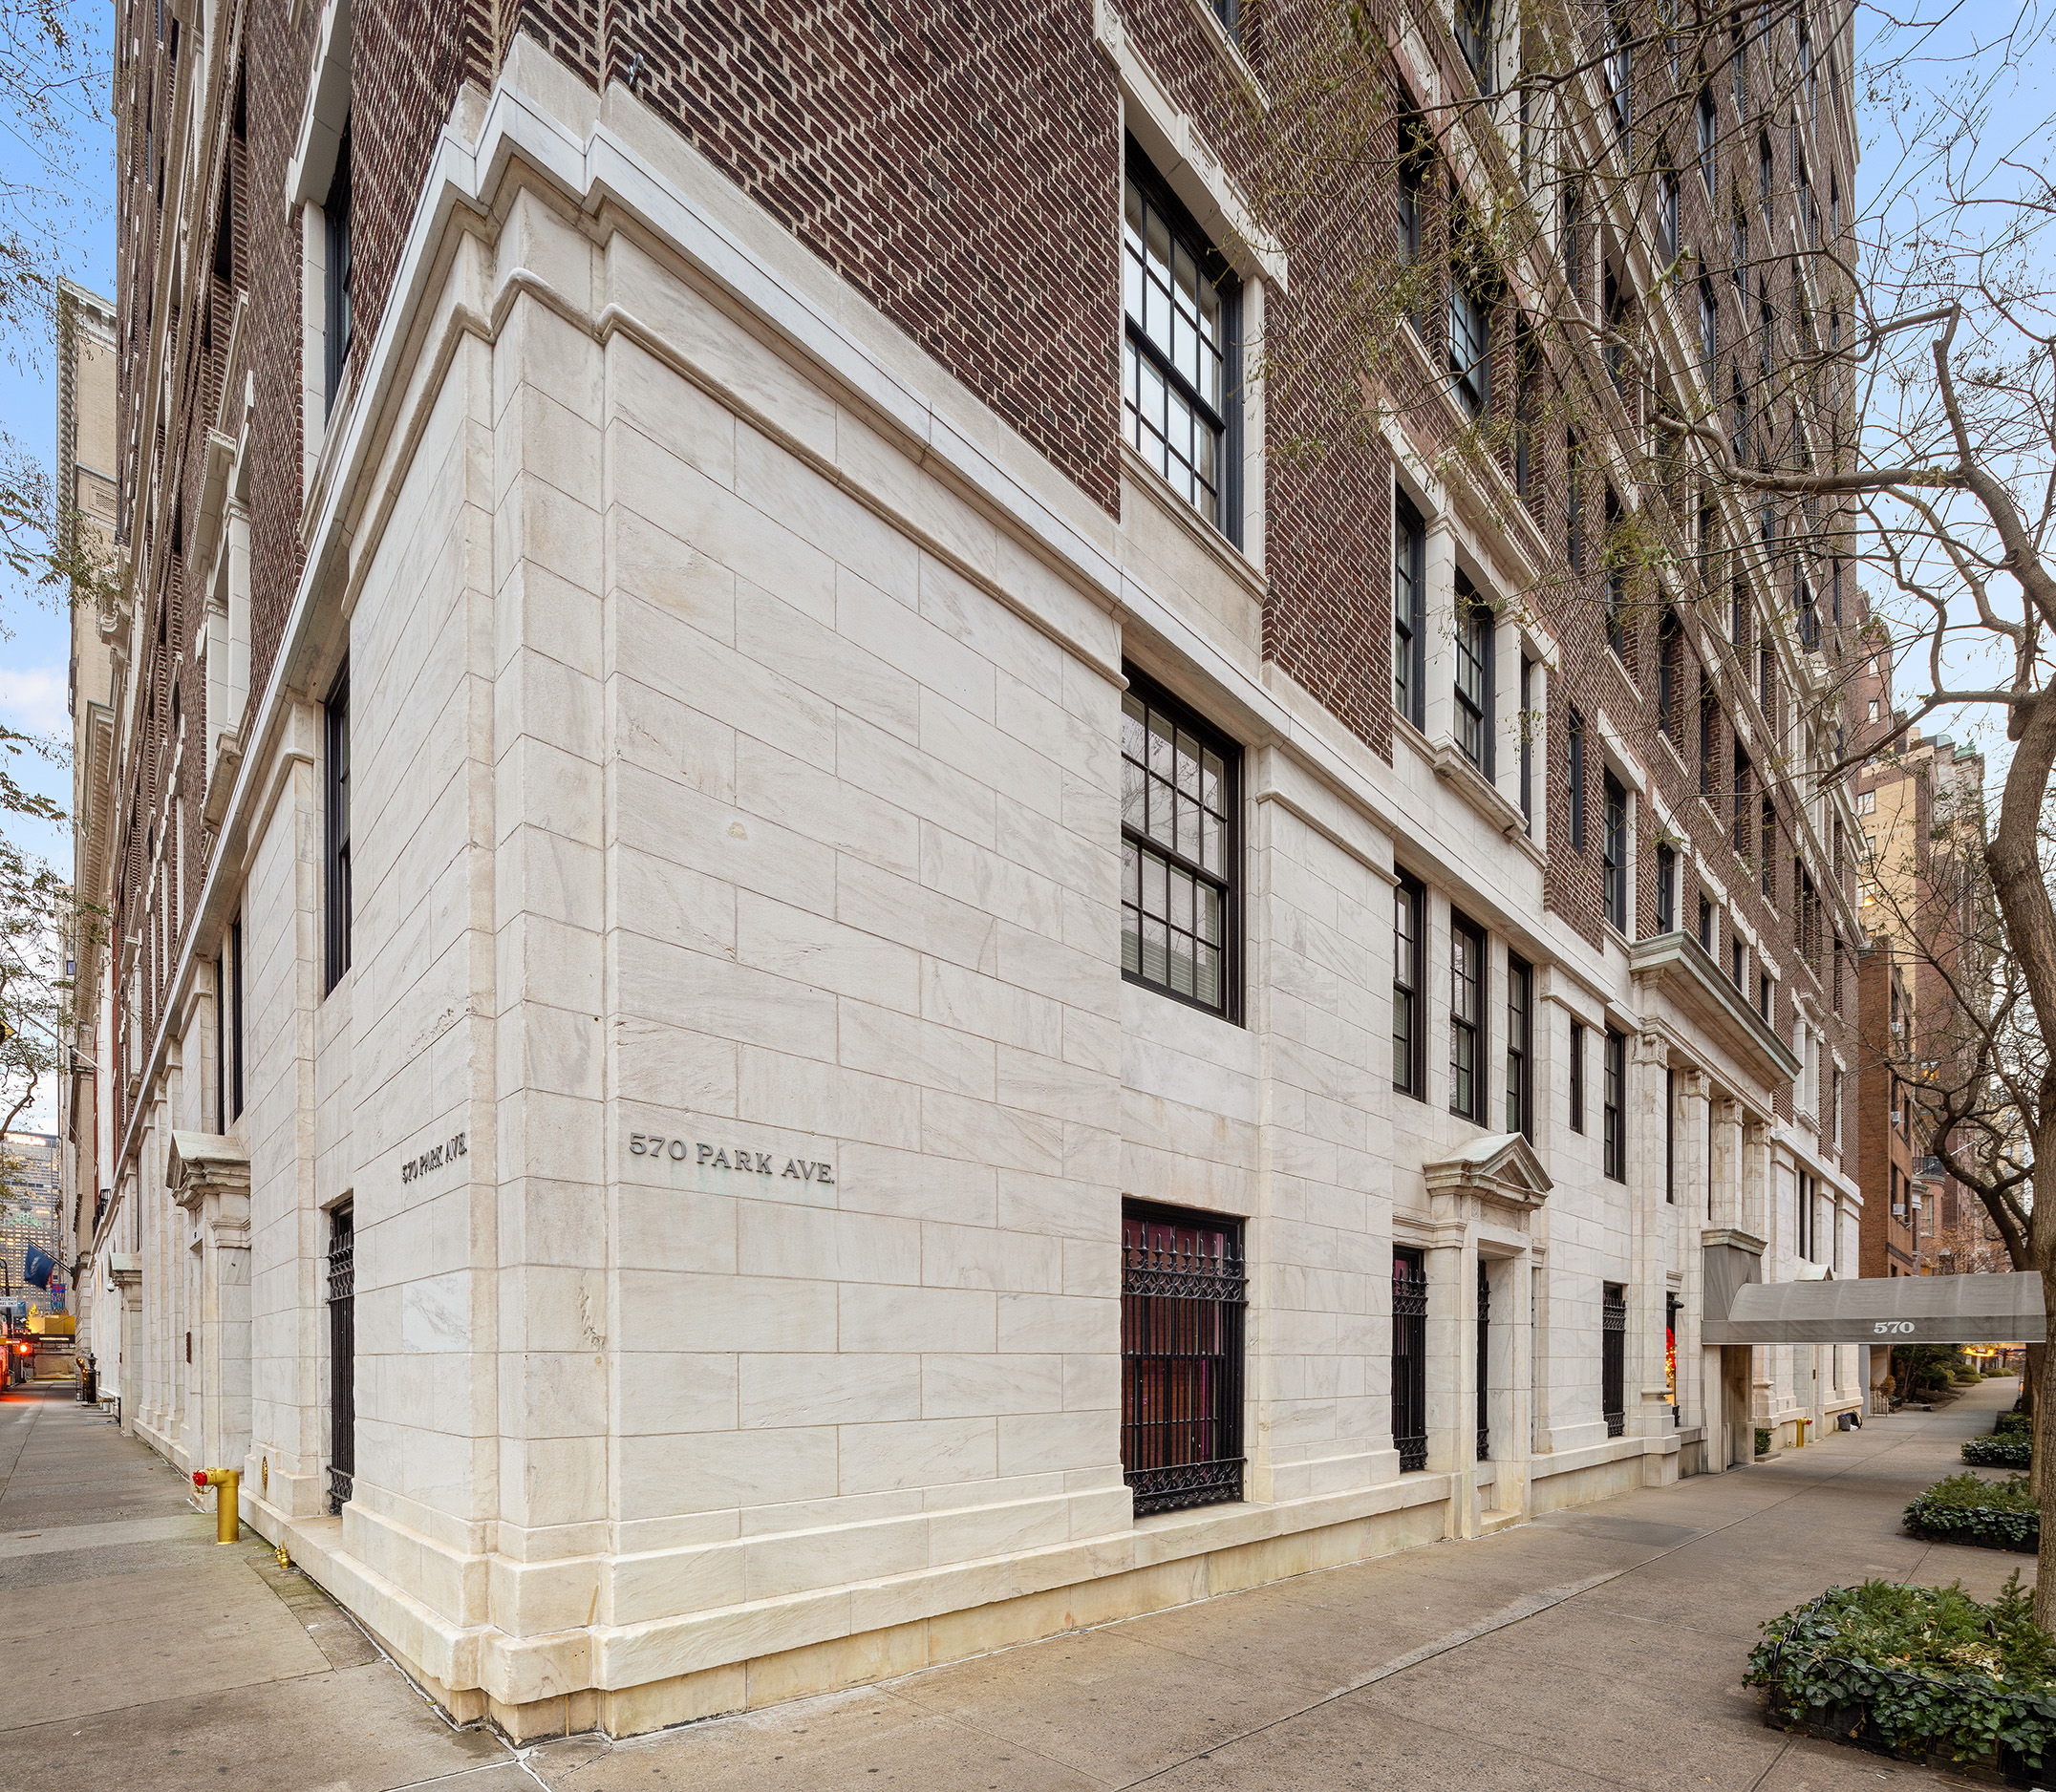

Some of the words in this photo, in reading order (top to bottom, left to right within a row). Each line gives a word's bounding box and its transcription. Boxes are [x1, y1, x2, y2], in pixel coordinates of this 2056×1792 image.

[401, 1159, 418, 1184] 570
[419, 1144, 443, 1176] PARK
[629, 1132, 687, 1161] 570
[696, 1142, 773, 1175] PARK
[781, 1159, 835, 1184] AVE.
[1874, 1321, 1915, 1333] 570
